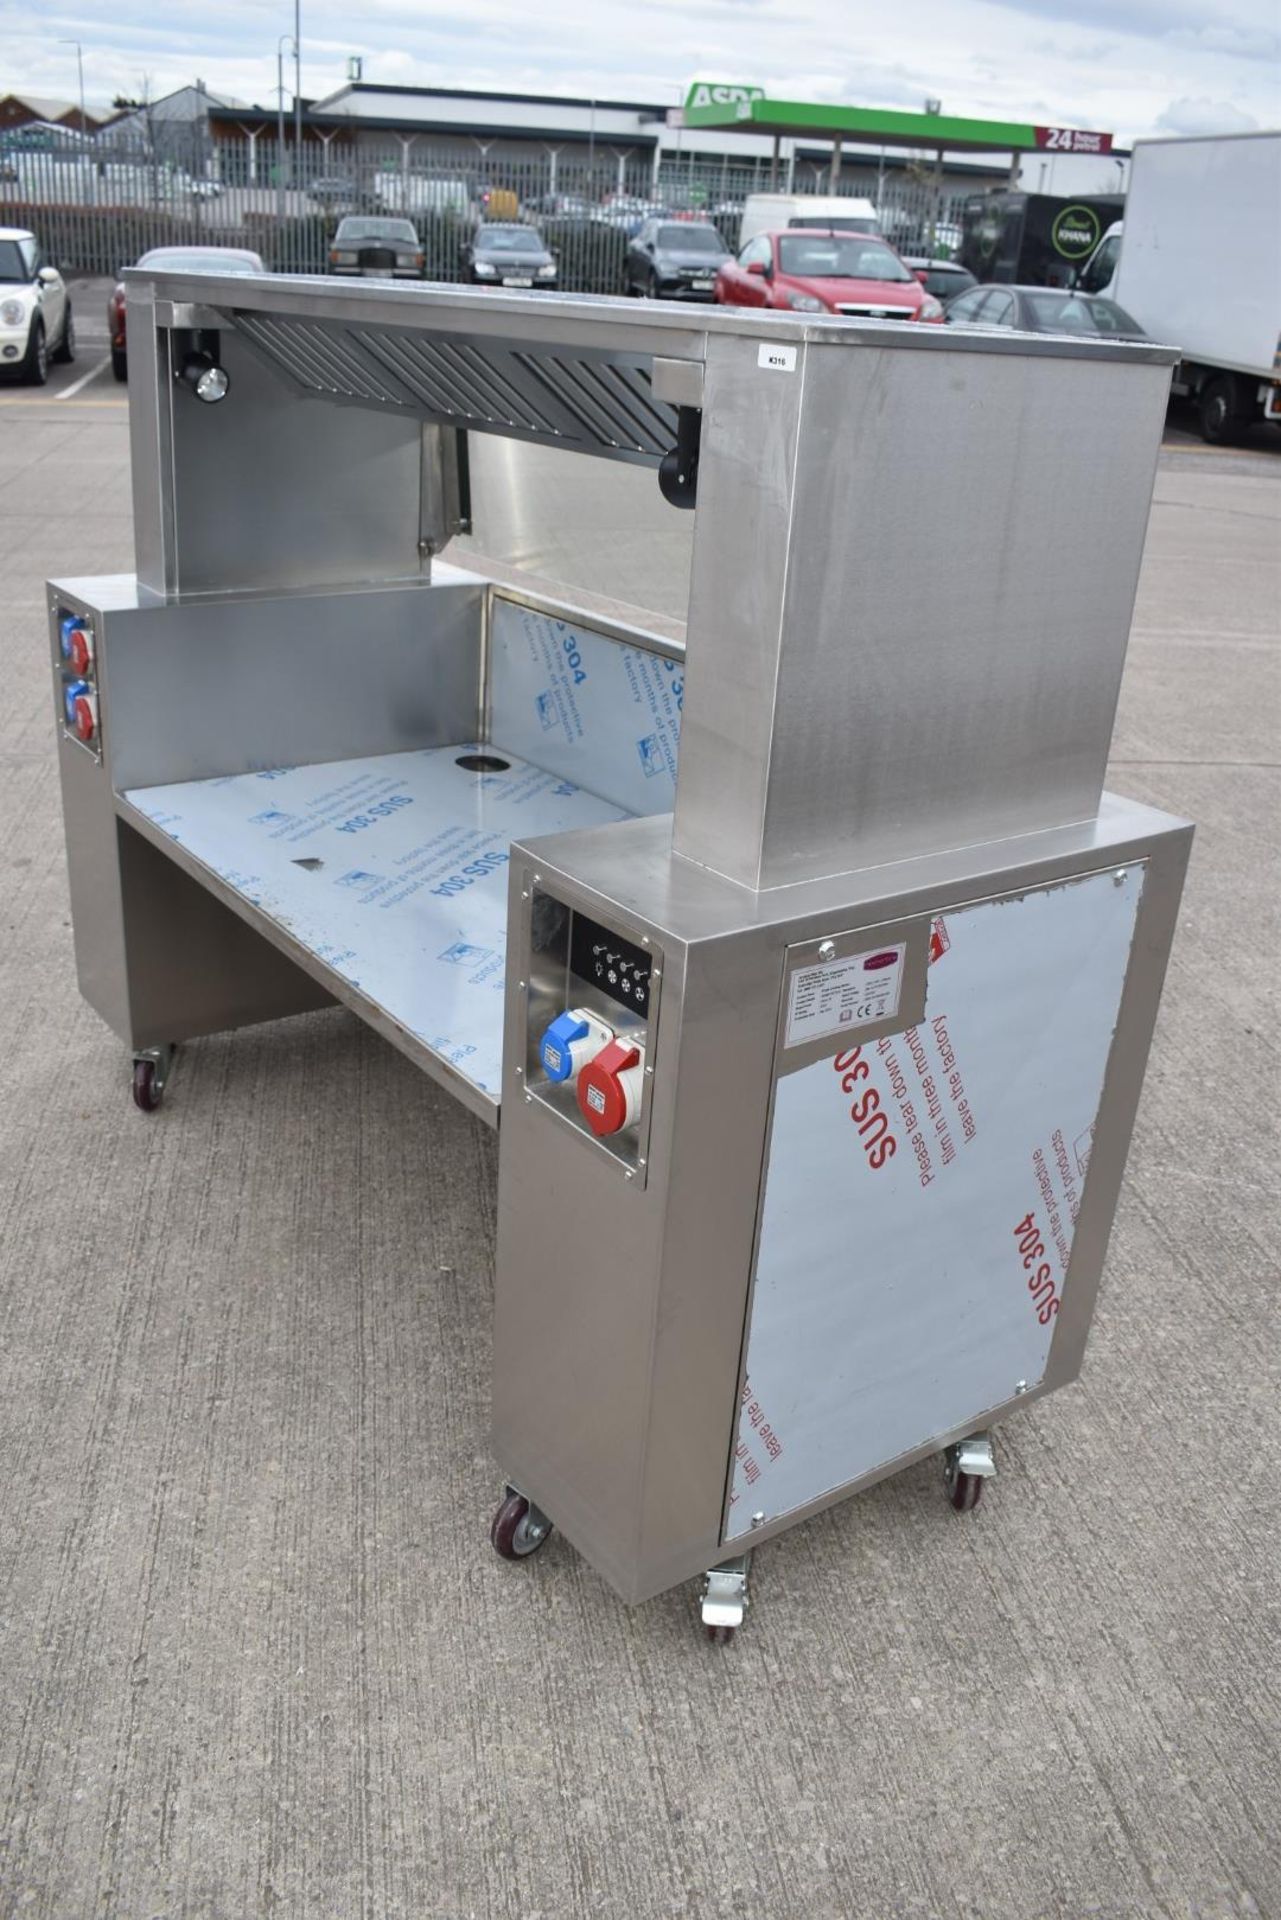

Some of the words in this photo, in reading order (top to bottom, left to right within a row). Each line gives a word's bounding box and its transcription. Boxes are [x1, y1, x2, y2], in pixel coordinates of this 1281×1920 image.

[1046, 128, 1072, 150] 24
[563, 635, 587, 685] 304
[624, 655, 643, 703] factory
[639, 662, 659, 713] months
[655, 716, 665, 730] of
[335, 815, 378, 834] 304
[367, 795, 414, 817] SUS
[462, 852, 509, 877] SUS
[429, 875, 475, 897] 304
[931, 1015, 956, 1074] factory
[884, 1053, 907, 1100] down
[949, 1071, 965, 1101] the
[899, 1100, 918, 1135] tear
[922, 1075, 942, 1120] three
[851, 1088, 897, 1170] SUS
[935, 1116, 947, 1138] in
[958, 1098, 977, 1145] leave
[911, 1132, 936, 1188] Please
[940, 1132, 957, 1166] film
[1051, 1128, 1075, 1186] products
[1032, 1148, 1059, 1214] protective
[1064, 1191, 1076, 1203] of
[1013, 1212, 1045, 1270] 304
[1049, 1212, 1063, 1238] the
[1028, 1263, 1060, 1325] SUS
[748, 1402, 765, 1429] the
[759, 1423, 783, 1463] leave
[743, 1457, 762, 1486] film
